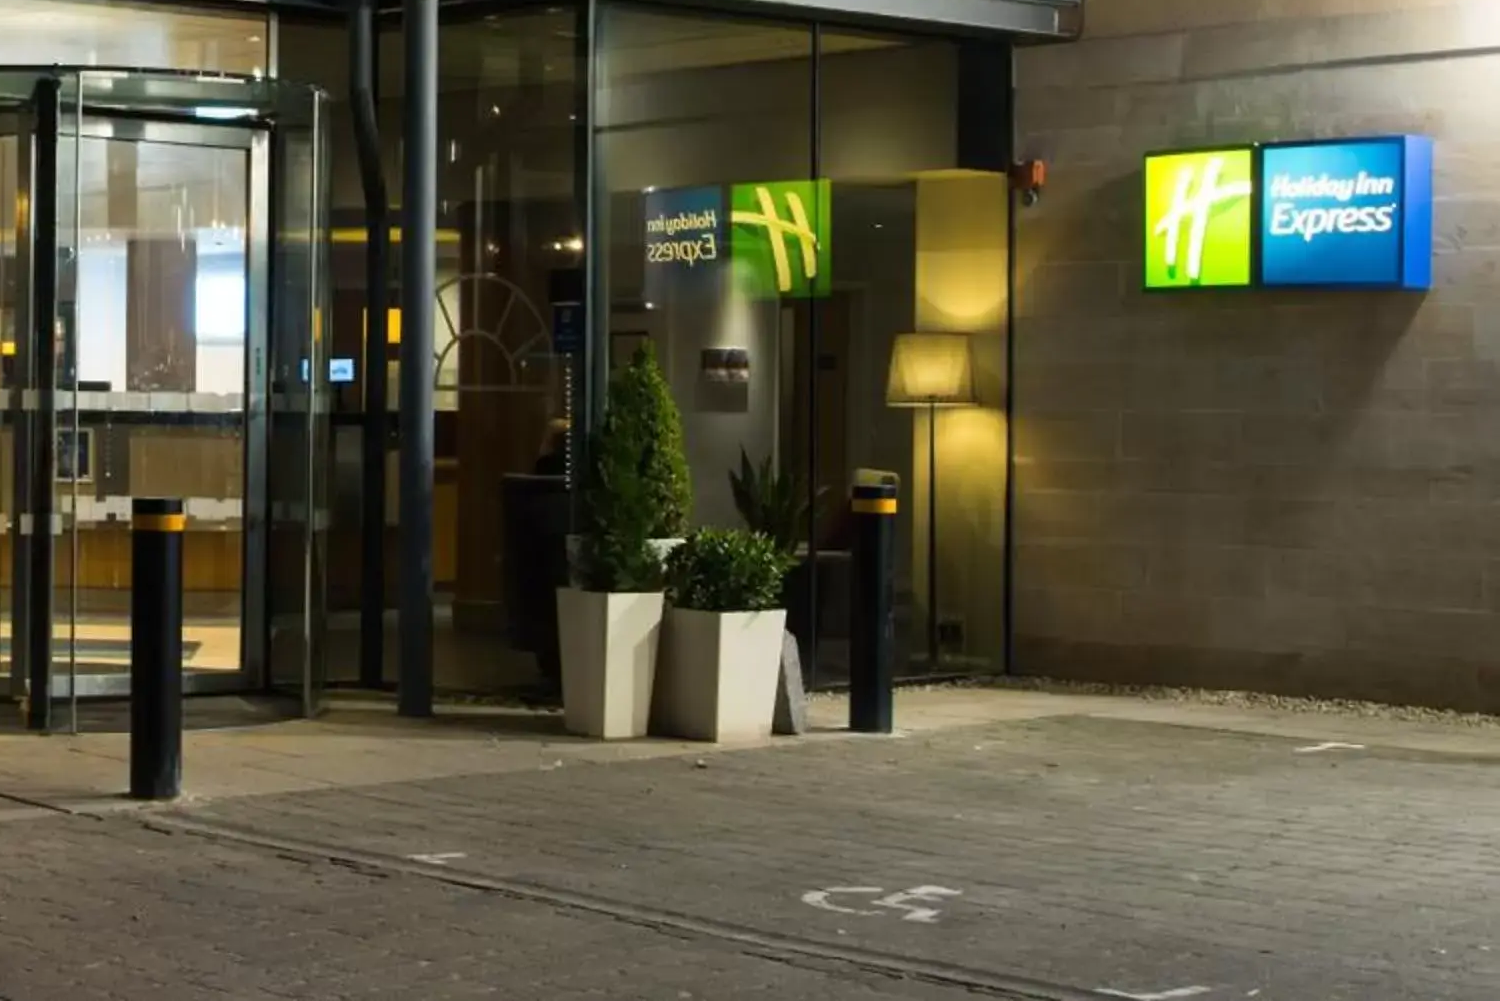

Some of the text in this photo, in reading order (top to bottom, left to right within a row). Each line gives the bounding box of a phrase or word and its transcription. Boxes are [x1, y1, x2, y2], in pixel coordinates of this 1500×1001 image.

[1270, 169, 1394, 201] Holiday Inn
[1269, 202, 1393, 242] Express
